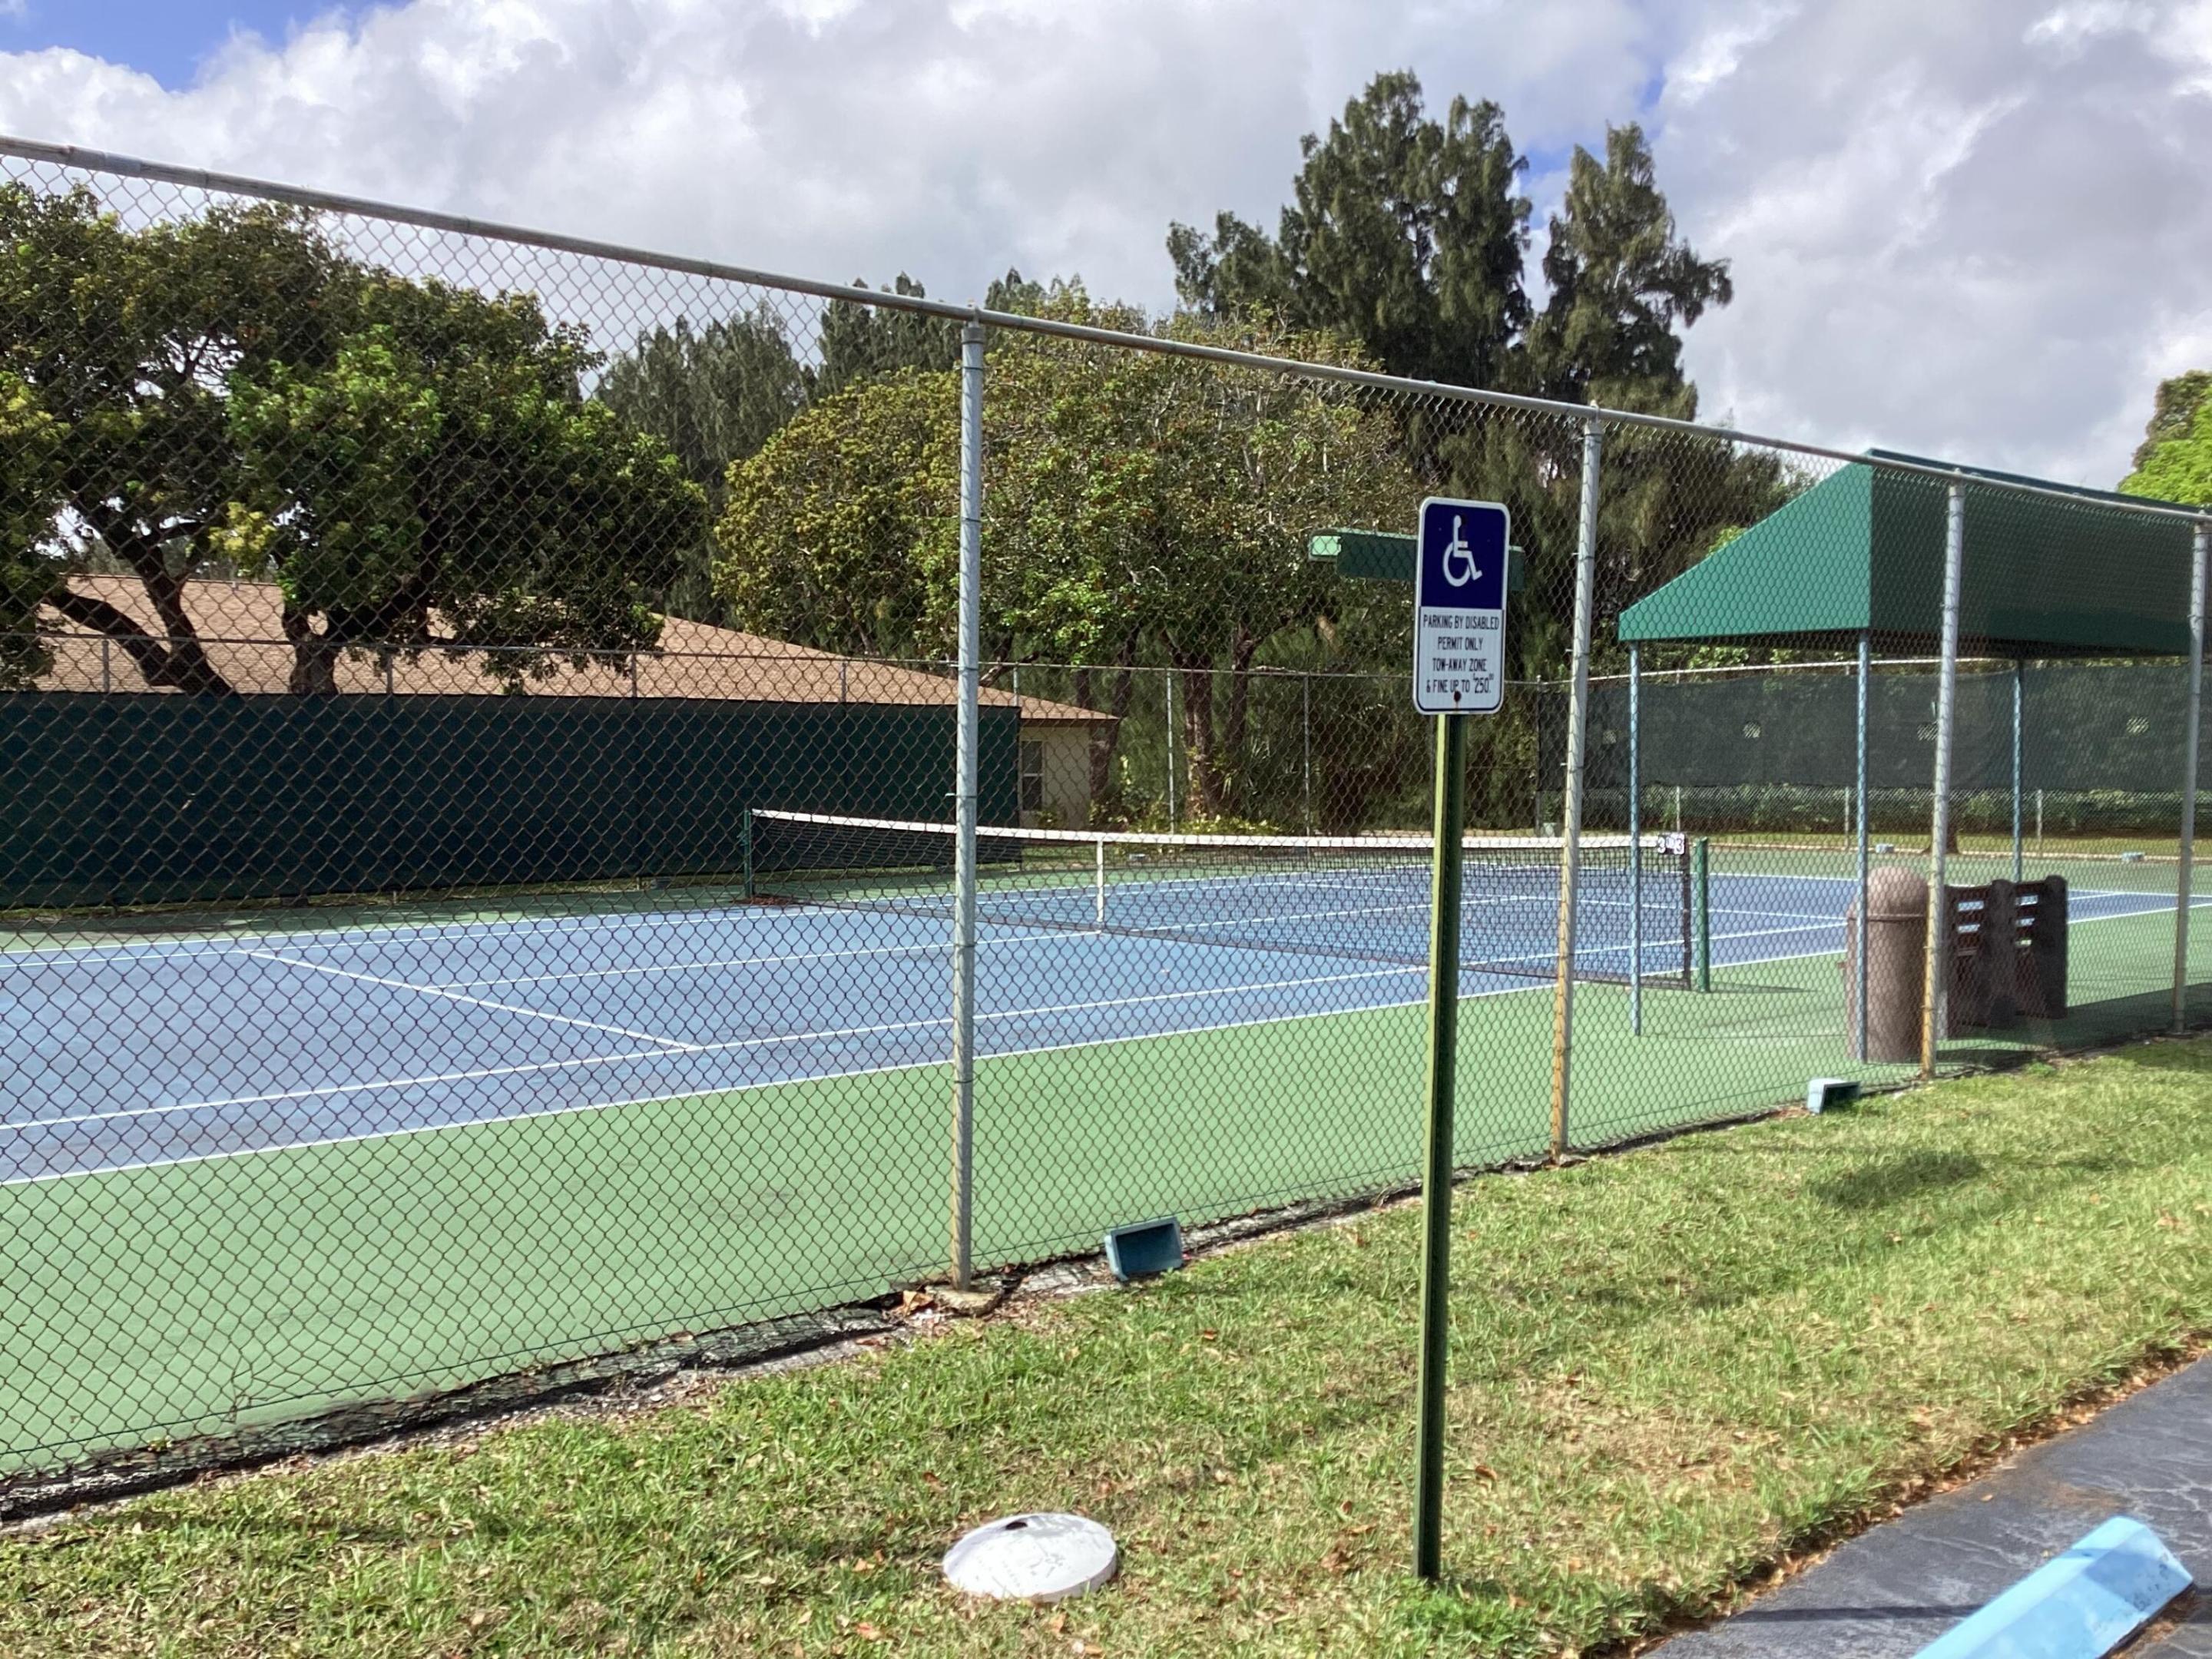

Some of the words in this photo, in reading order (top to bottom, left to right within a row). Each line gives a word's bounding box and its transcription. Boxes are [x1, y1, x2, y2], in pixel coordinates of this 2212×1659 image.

[1423, 614, 1452, 628] PARKING
[1454, 615, 1463, 629] BY
[1465, 615, 1499, 630] DISABLED
[1438, 636, 1463, 651] PERMIT
[1465, 637, 1483, 651] ONLY
[1432, 657, 1468, 671] TOW-AWAY
[1469, 657, 1487, 672] ZONE
[1433, 679, 1448, 693] FINE
[1450, 679, 1459, 693] UP
[1462, 679, 1470, 693] TO
